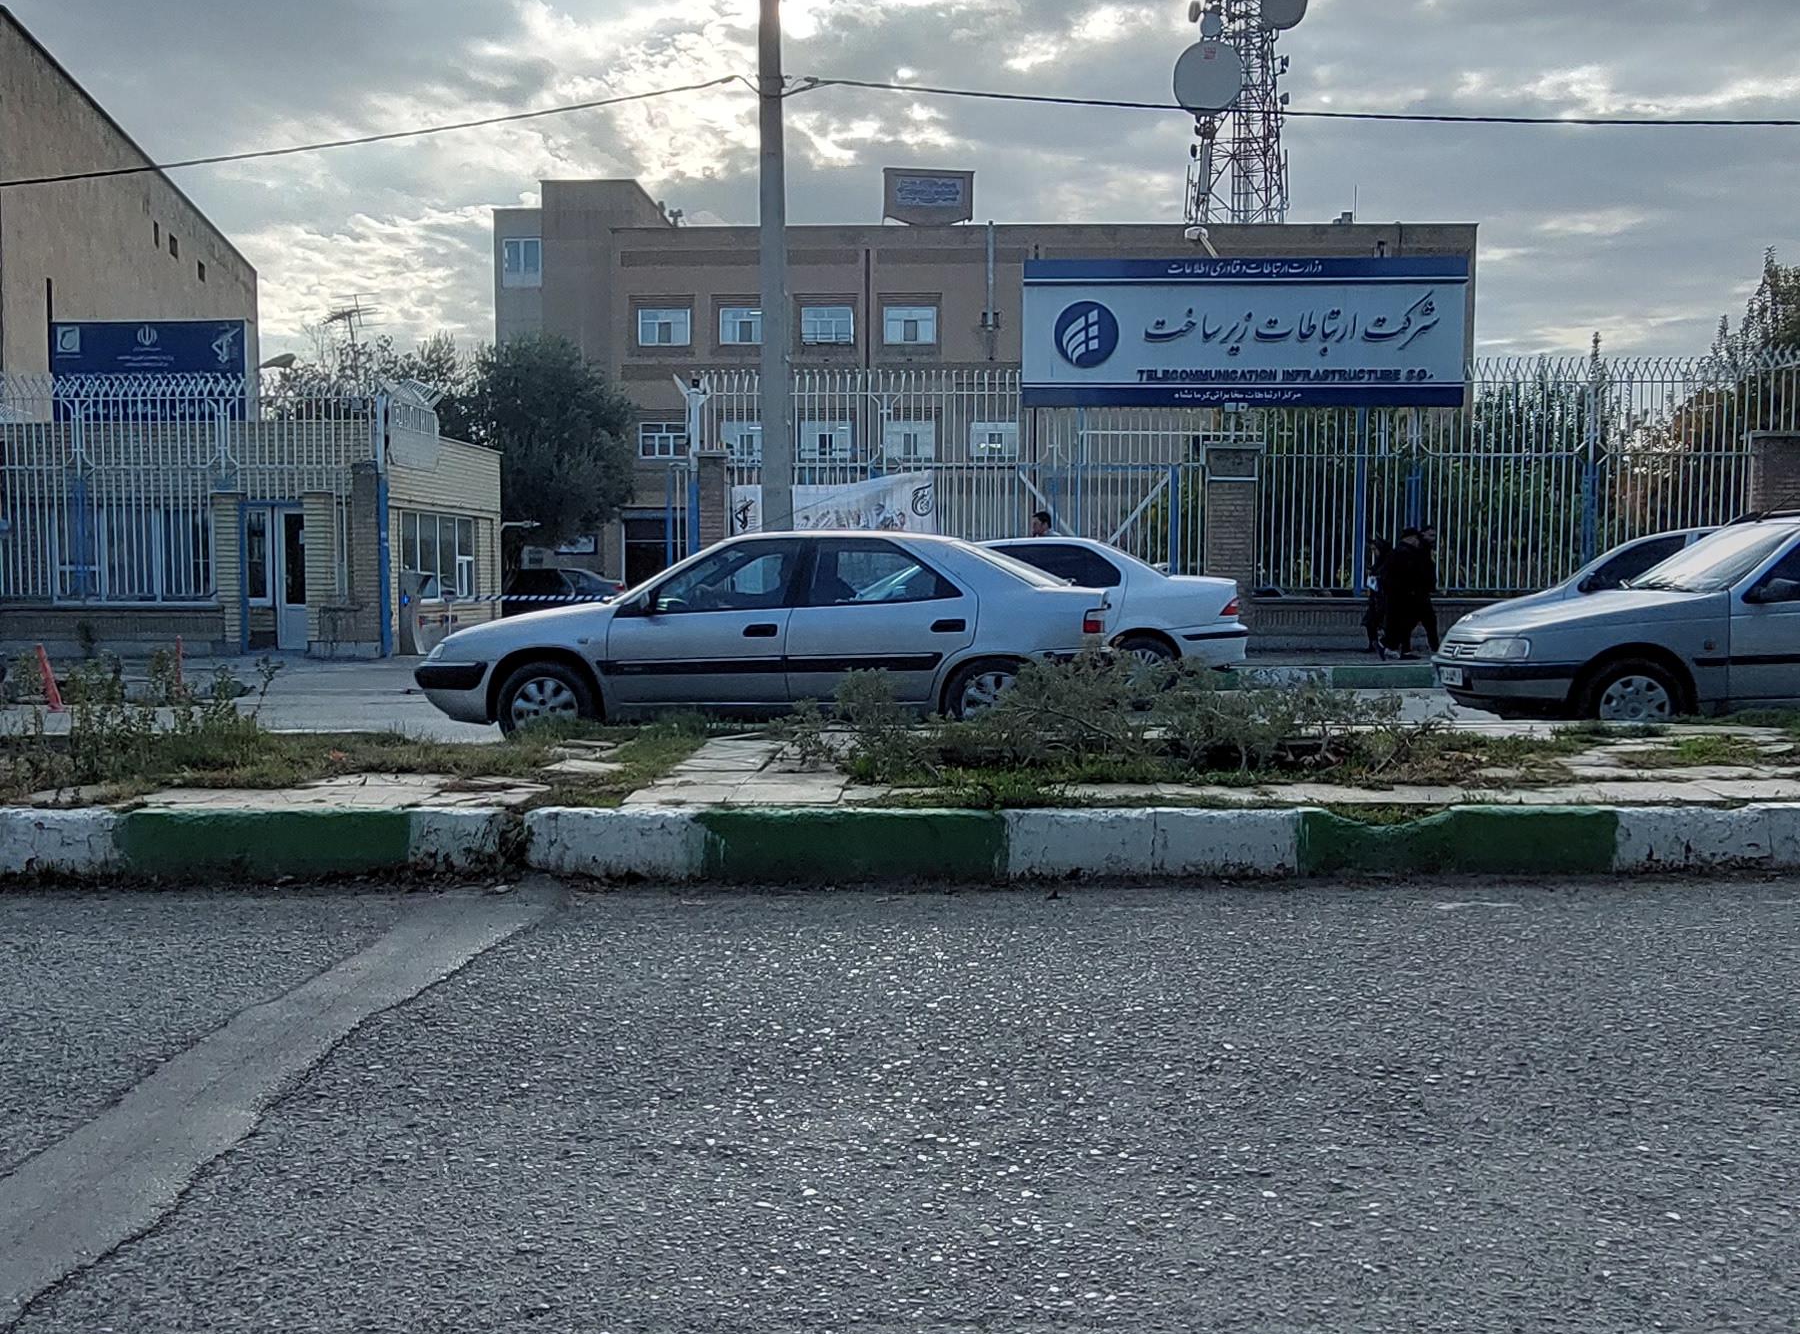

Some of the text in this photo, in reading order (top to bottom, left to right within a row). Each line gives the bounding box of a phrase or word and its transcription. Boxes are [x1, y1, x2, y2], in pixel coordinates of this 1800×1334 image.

[1168, 262, 1208, 274] اطلاعات
[1210, 260, 1240, 276] فناوری
[1246, 262, 1288, 277] ارتباطات
[1288, 260, 1322, 274] وزارت
[1362, 290, 1440, 351] شرکت
[1254, 308, 1356, 357] ارتباطات
[1137, 369, 1277, 382] TELECOMMUNICATION
[1282, 369, 1400, 382] INFRASTRUCTURE
